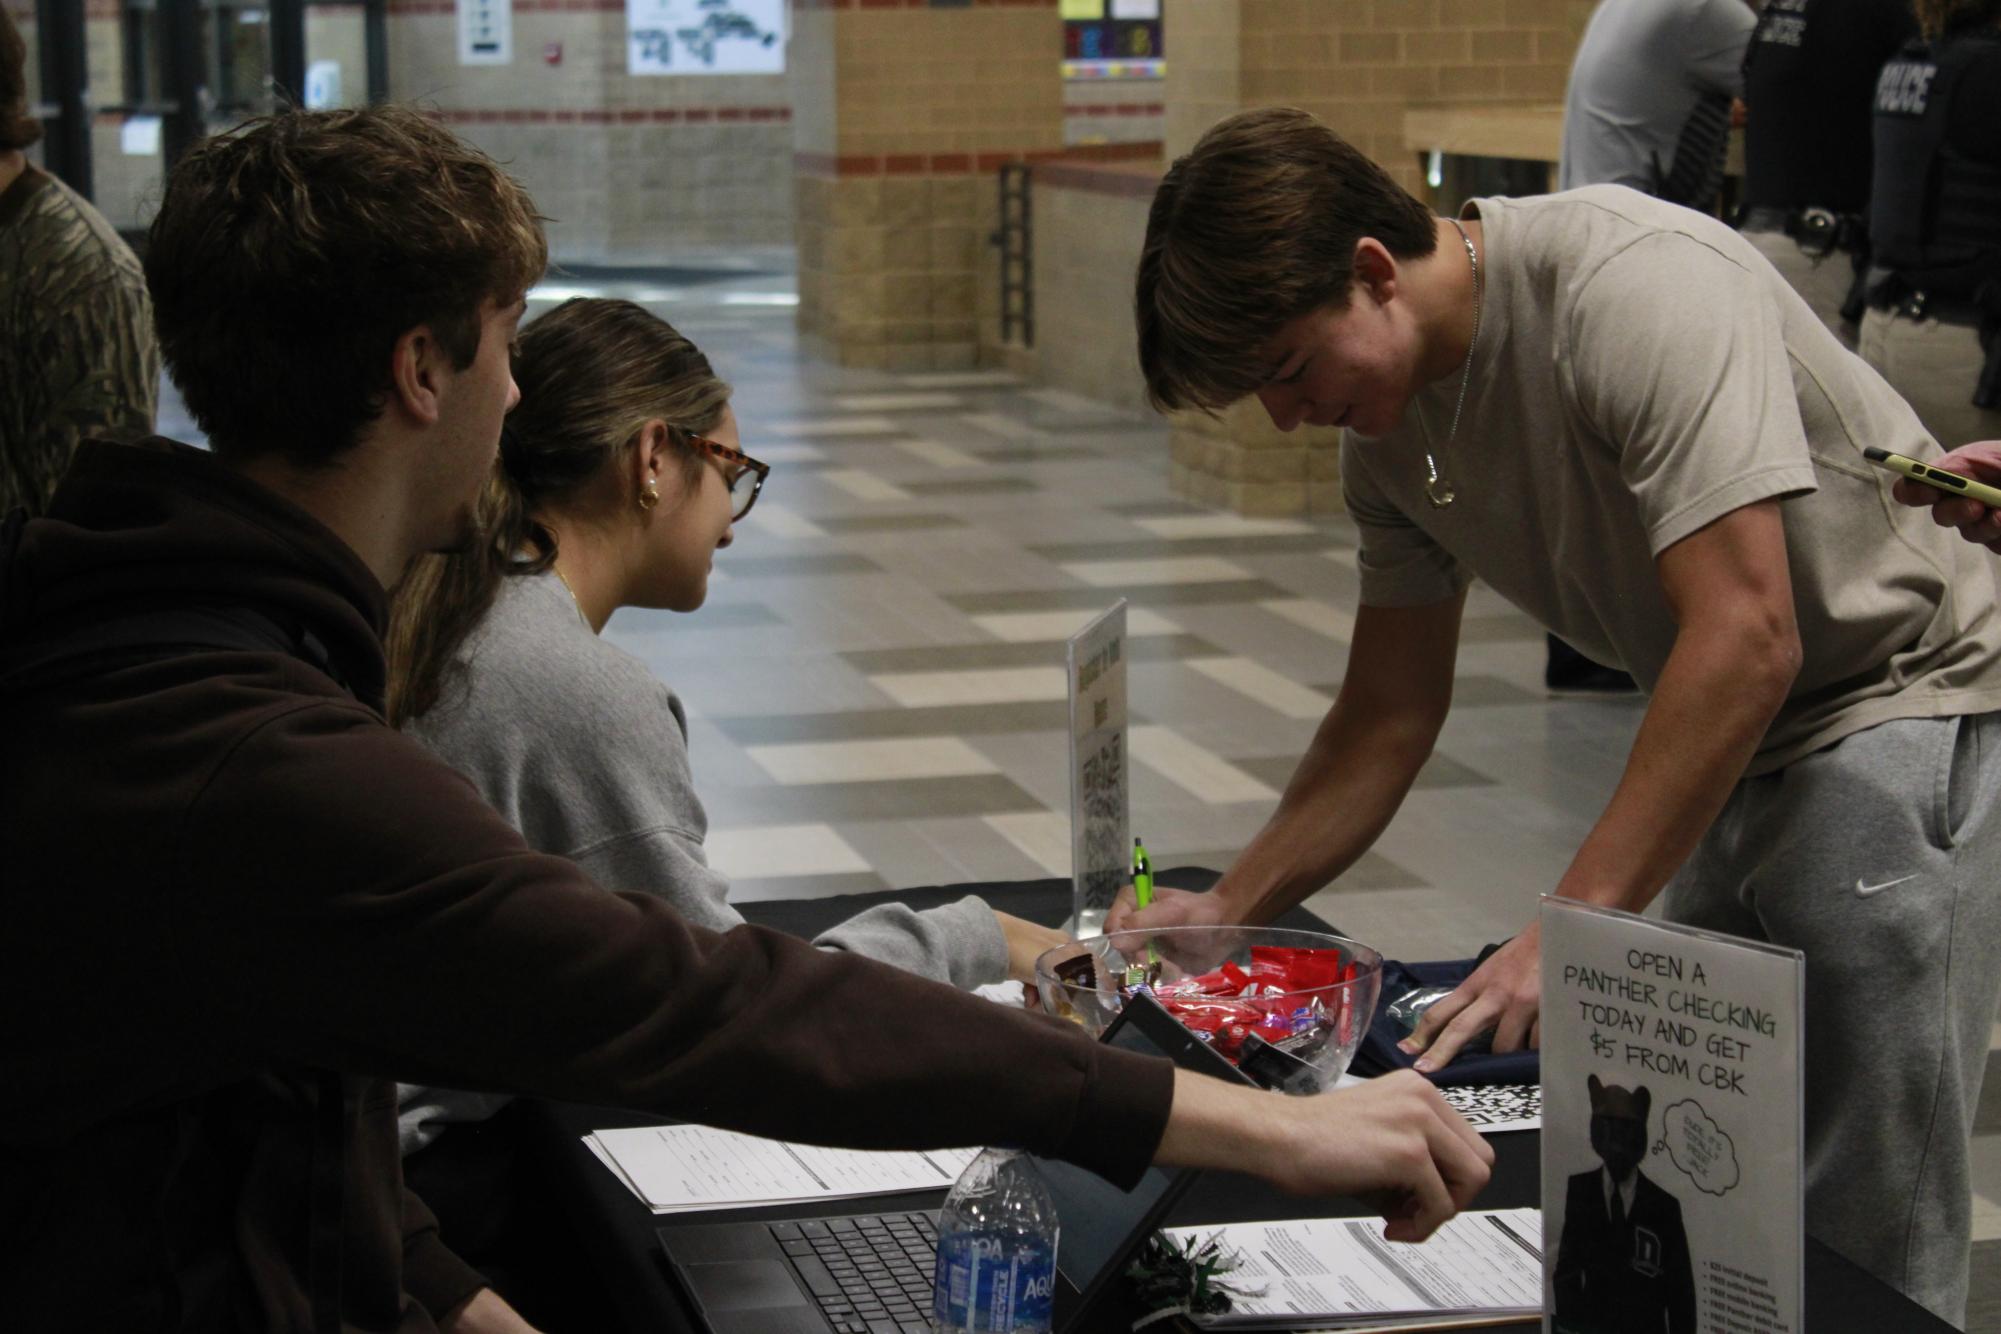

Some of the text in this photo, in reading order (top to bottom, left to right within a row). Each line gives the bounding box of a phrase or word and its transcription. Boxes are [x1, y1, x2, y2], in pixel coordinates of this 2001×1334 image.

[1627, 949, 1707, 986] OPEN A
[1564, 965, 1776, 1038] PANTHER CHECKING
[1579, 1001, 1751, 1062] TODAY AND GET
[1590, 1027, 1748, 1096] $5 FROM CBK
